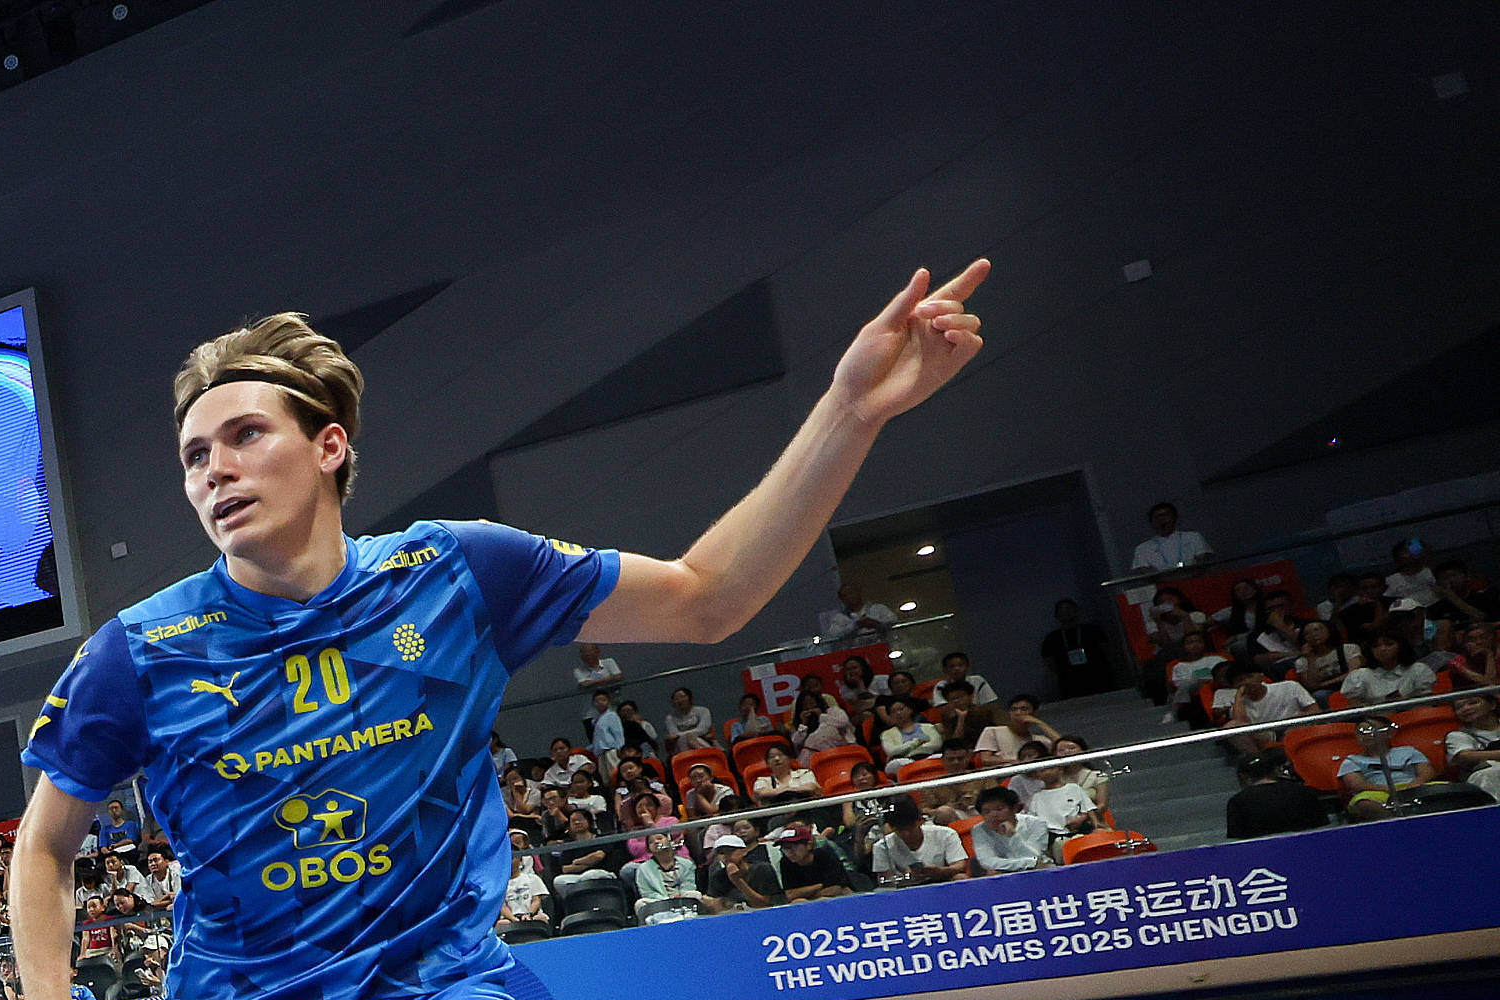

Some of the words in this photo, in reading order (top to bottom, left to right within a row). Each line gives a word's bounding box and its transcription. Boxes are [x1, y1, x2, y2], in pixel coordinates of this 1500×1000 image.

[145, 611, 228, 643] stadium
[285, 647, 351, 714] 20
[760, 674, 801, 715] B
[255, 712, 434, 772] PANTAMERA
[261, 843, 393, 891] OBOS
[762, 867, 1289, 964] 2025年第12届世界运动会
[769, 967, 824, 990] THE
[827, 954, 933, 983] WORLD
[937, 939, 1046, 968] GAMES
[1051, 929, 1134, 957] 2025
[1138, 906, 1299, 946] CHENGDU
